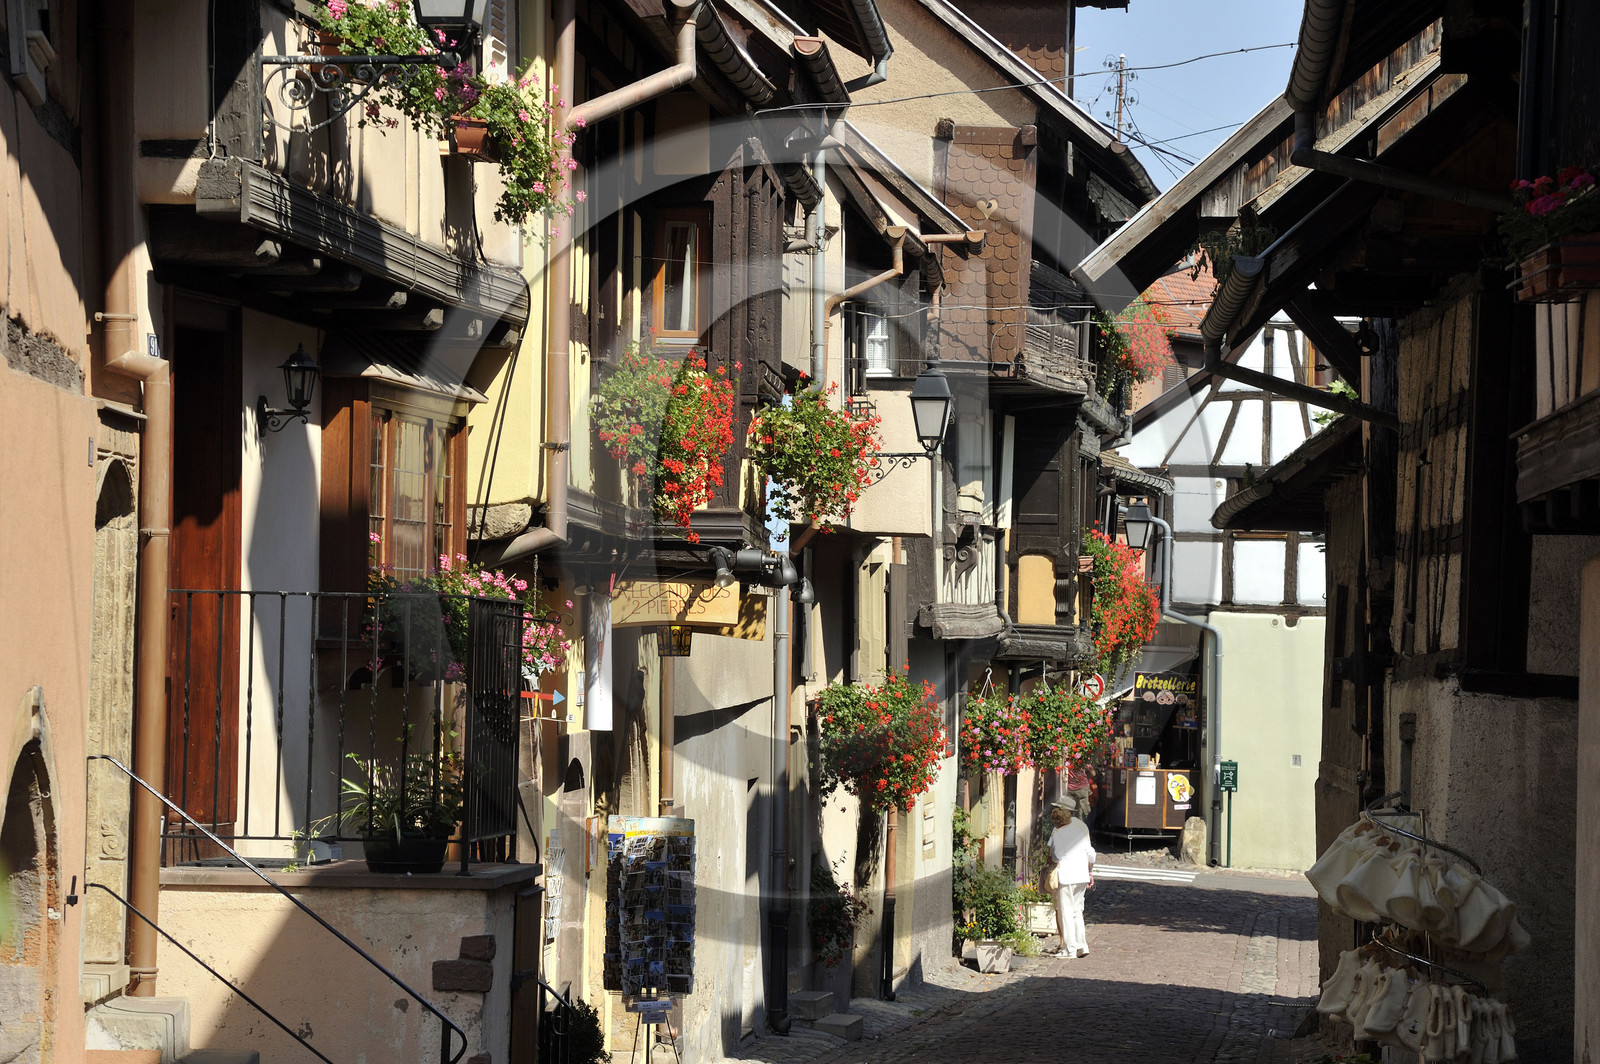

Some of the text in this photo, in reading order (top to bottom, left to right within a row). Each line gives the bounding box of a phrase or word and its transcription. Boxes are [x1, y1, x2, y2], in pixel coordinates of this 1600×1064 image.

[150, 337, 158, 356] 91
[632, 583, 698, 599] LEGENDE
[702, 583, 731, 599] DES
[631, 599, 706, 615] 2 PIERRES
[1136, 674, 1196, 691] Bretzellerie
